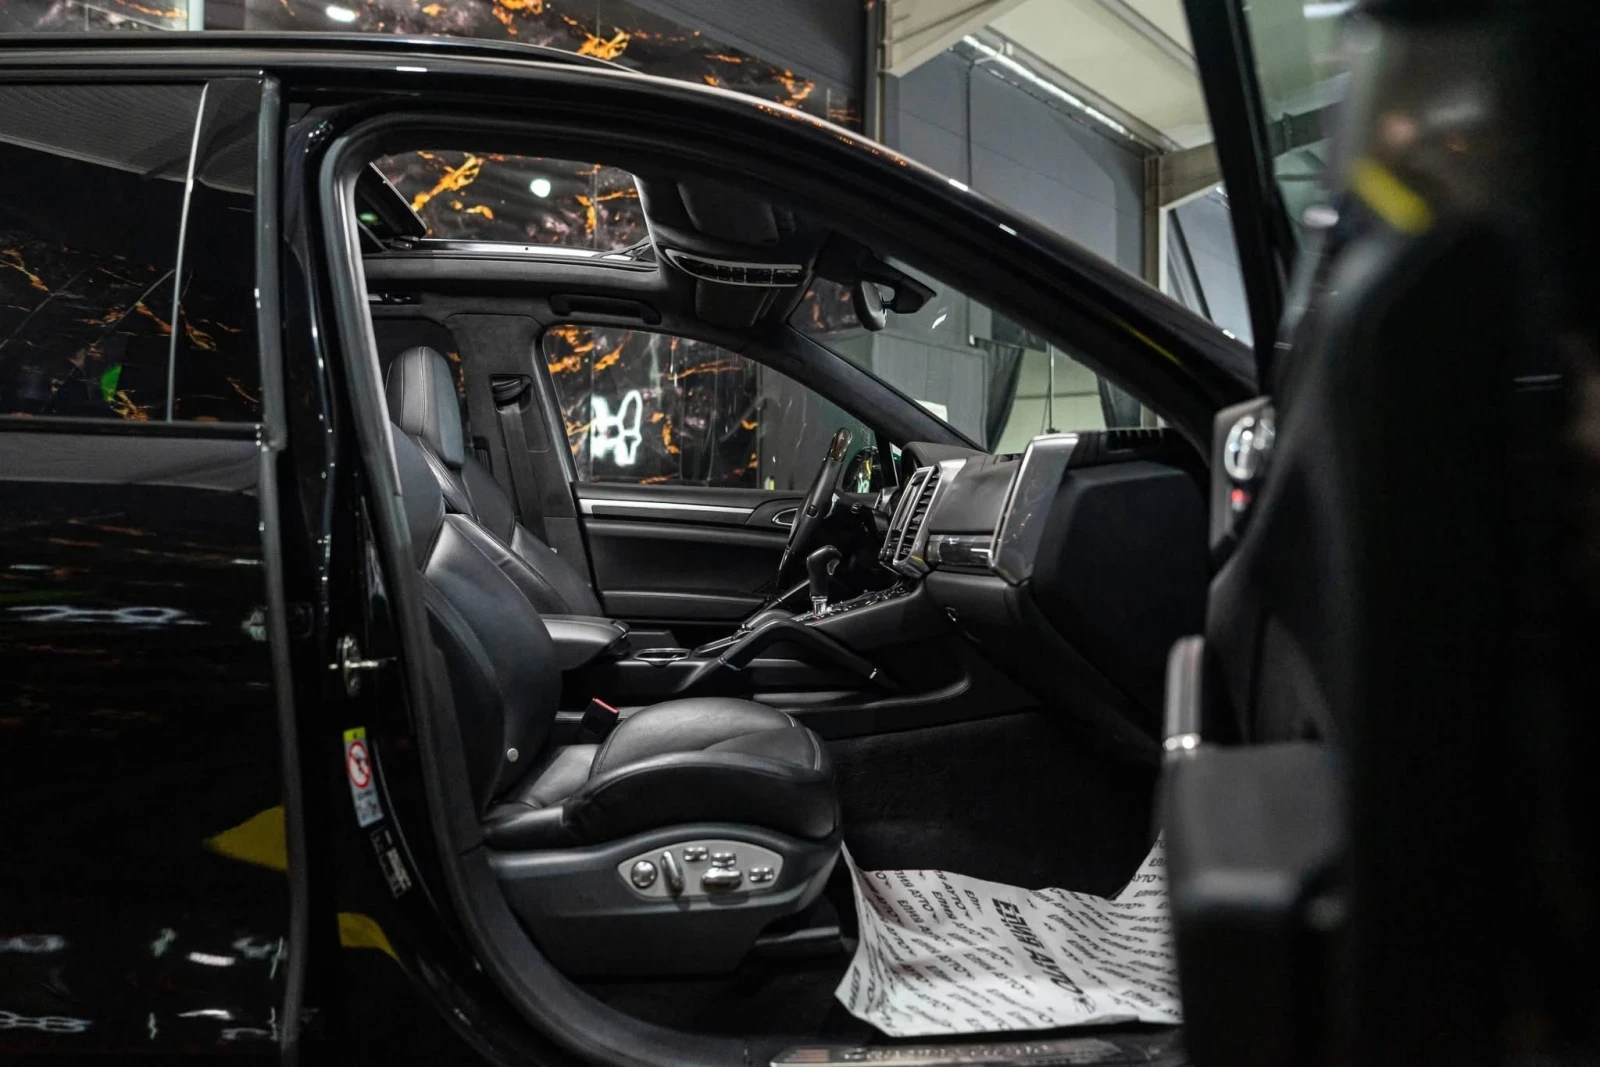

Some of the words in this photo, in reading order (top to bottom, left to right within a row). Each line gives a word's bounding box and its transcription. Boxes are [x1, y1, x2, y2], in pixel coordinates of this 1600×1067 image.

[908, 889, 935, 912] АУТО
[942, 881, 966, 910] АУТО
[1023, 946, 1084, 994] АУТО
